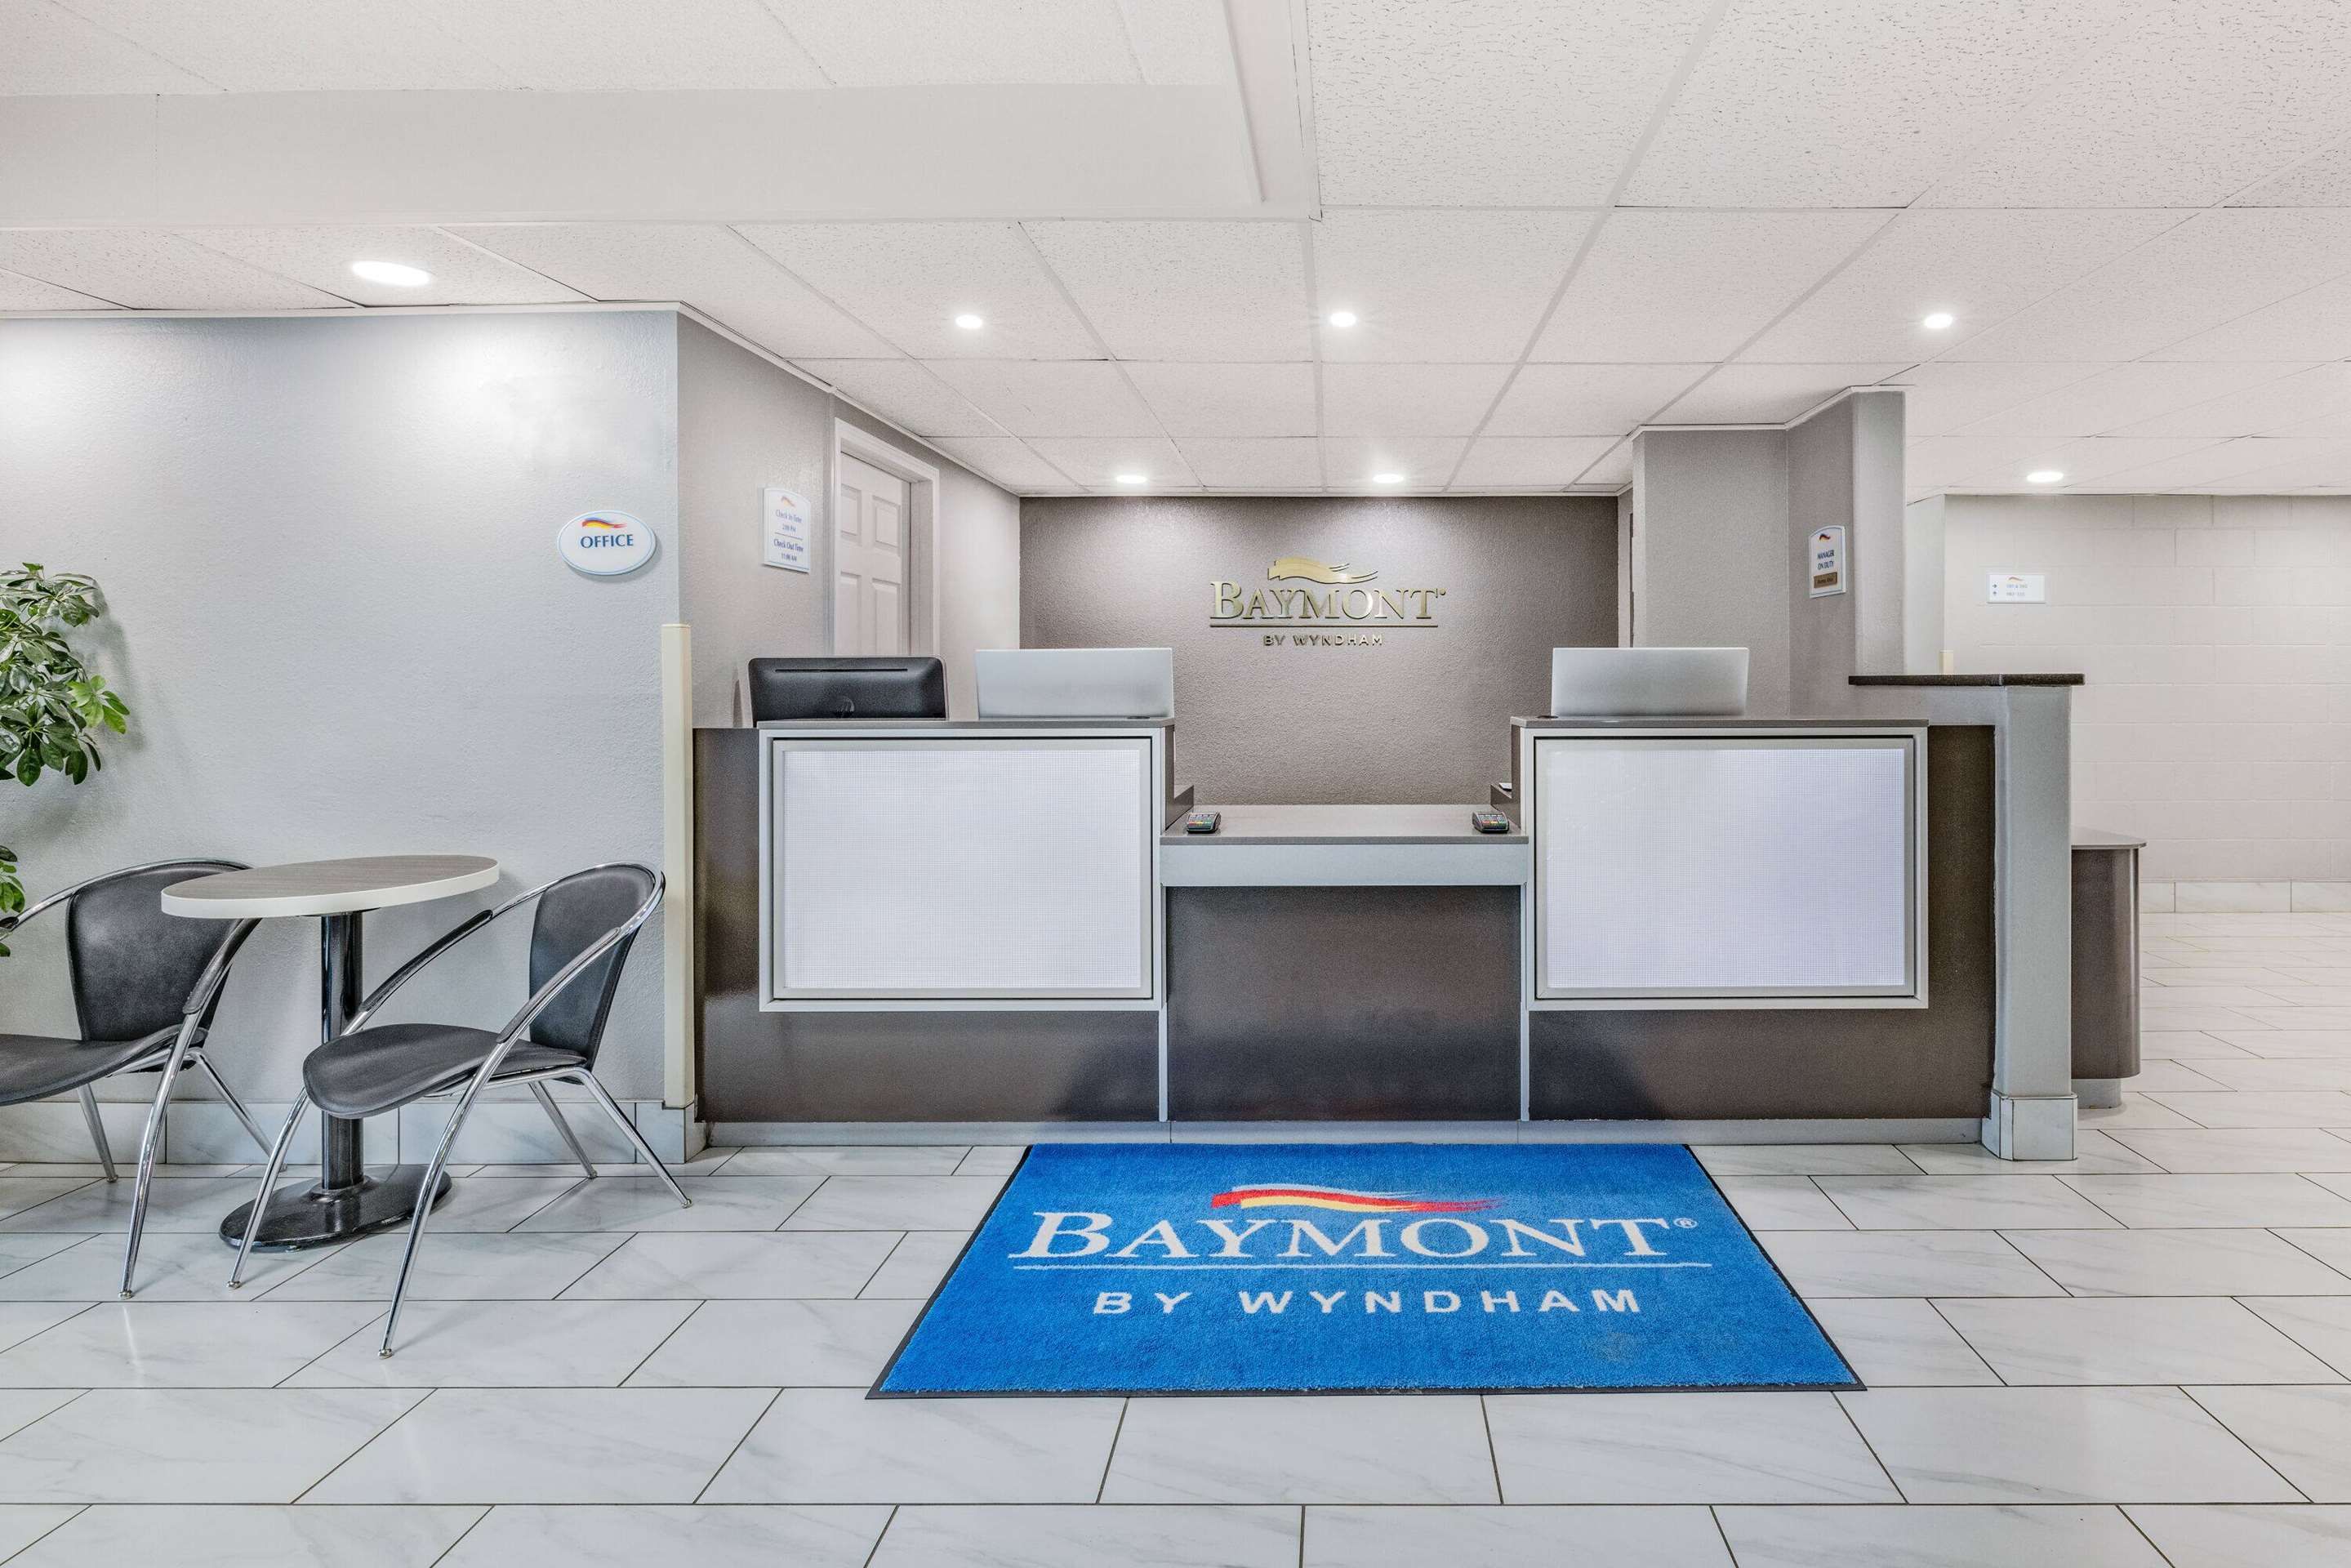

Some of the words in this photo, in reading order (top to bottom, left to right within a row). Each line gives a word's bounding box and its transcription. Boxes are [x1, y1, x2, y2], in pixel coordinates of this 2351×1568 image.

[581, 534, 634, 549] OFFICE
[773, 538, 786, 548] Check
[786, 541, 795, 550] Out
[795, 544, 804, 552] Time
[1817, 550, 1834, 559] MANAGER
[1824, 561, 1834, 569] DUTY
[1263, 635, 1285, 646] BY
[1293, 635, 1383, 647] WYNDHAM
[1093, 1291, 1192, 1314] BY
[1239, 1290, 1641, 1314] WYNDHAM
